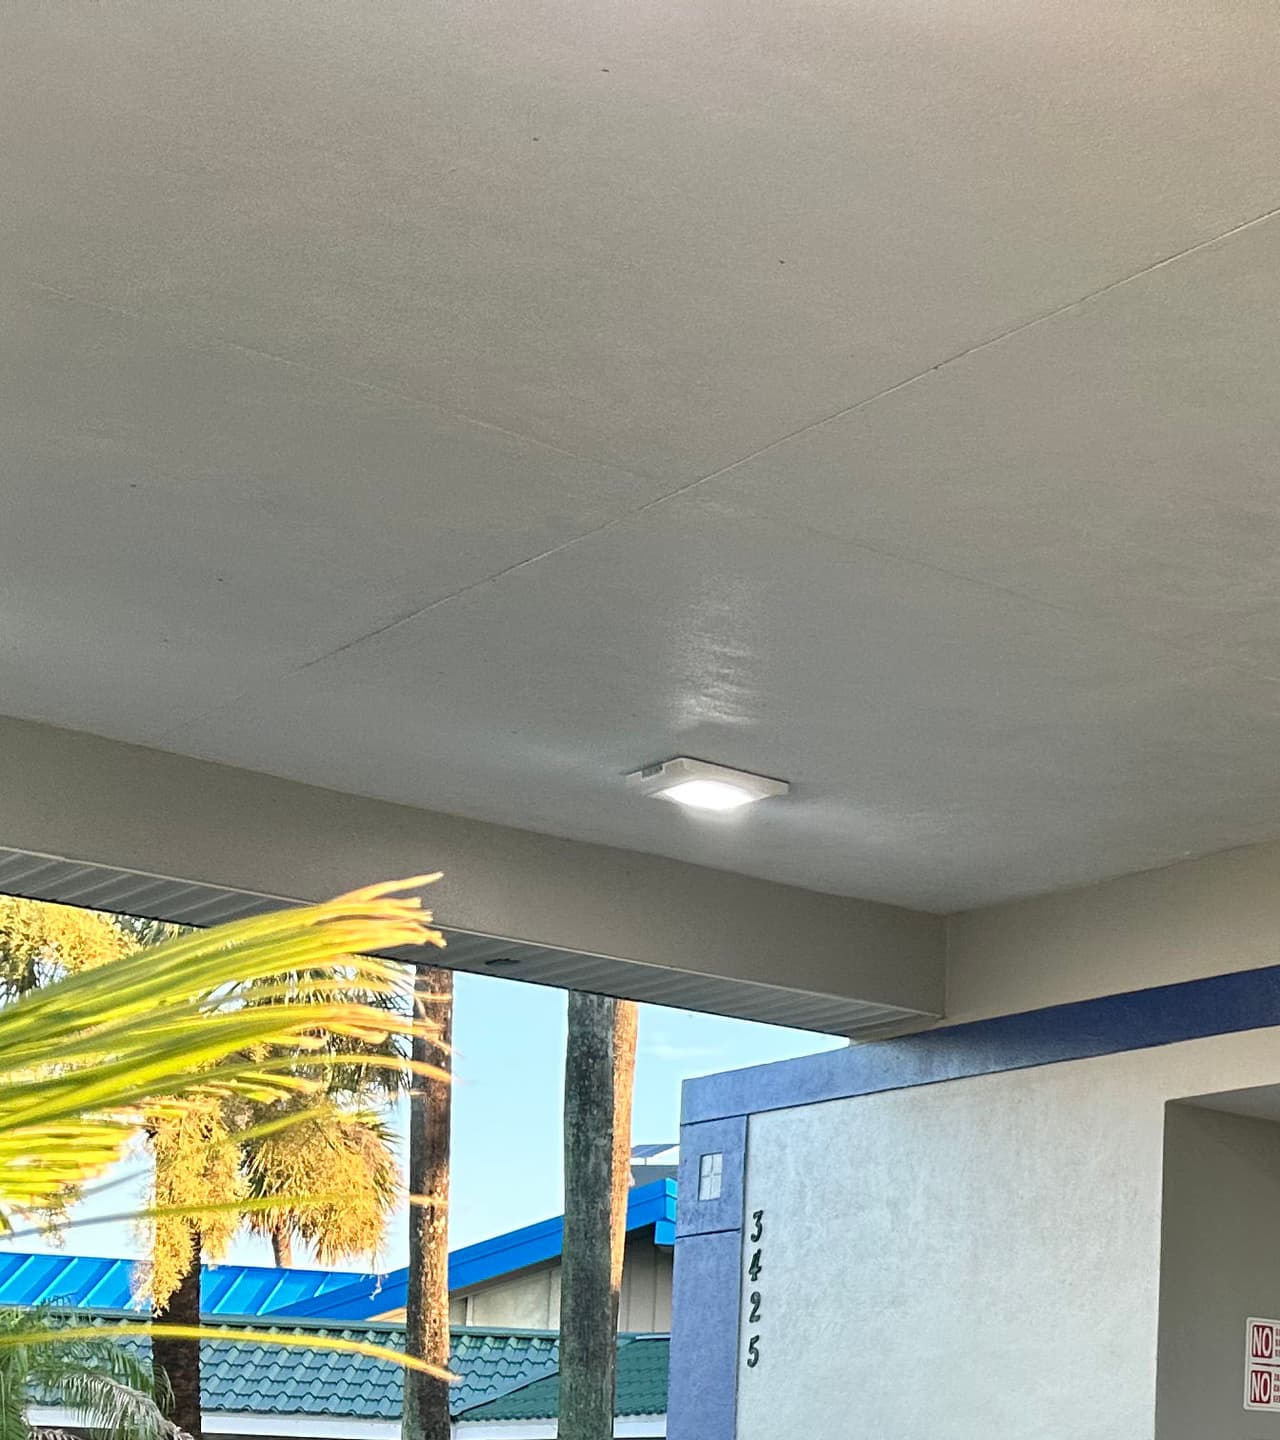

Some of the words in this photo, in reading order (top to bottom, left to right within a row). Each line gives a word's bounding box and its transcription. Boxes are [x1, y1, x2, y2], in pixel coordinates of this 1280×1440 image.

[747, 1210, 764, 1368] 3425
[1252, 1326, 1272, 1357] NO
[1251, 1371, 1271, 1402] NO
